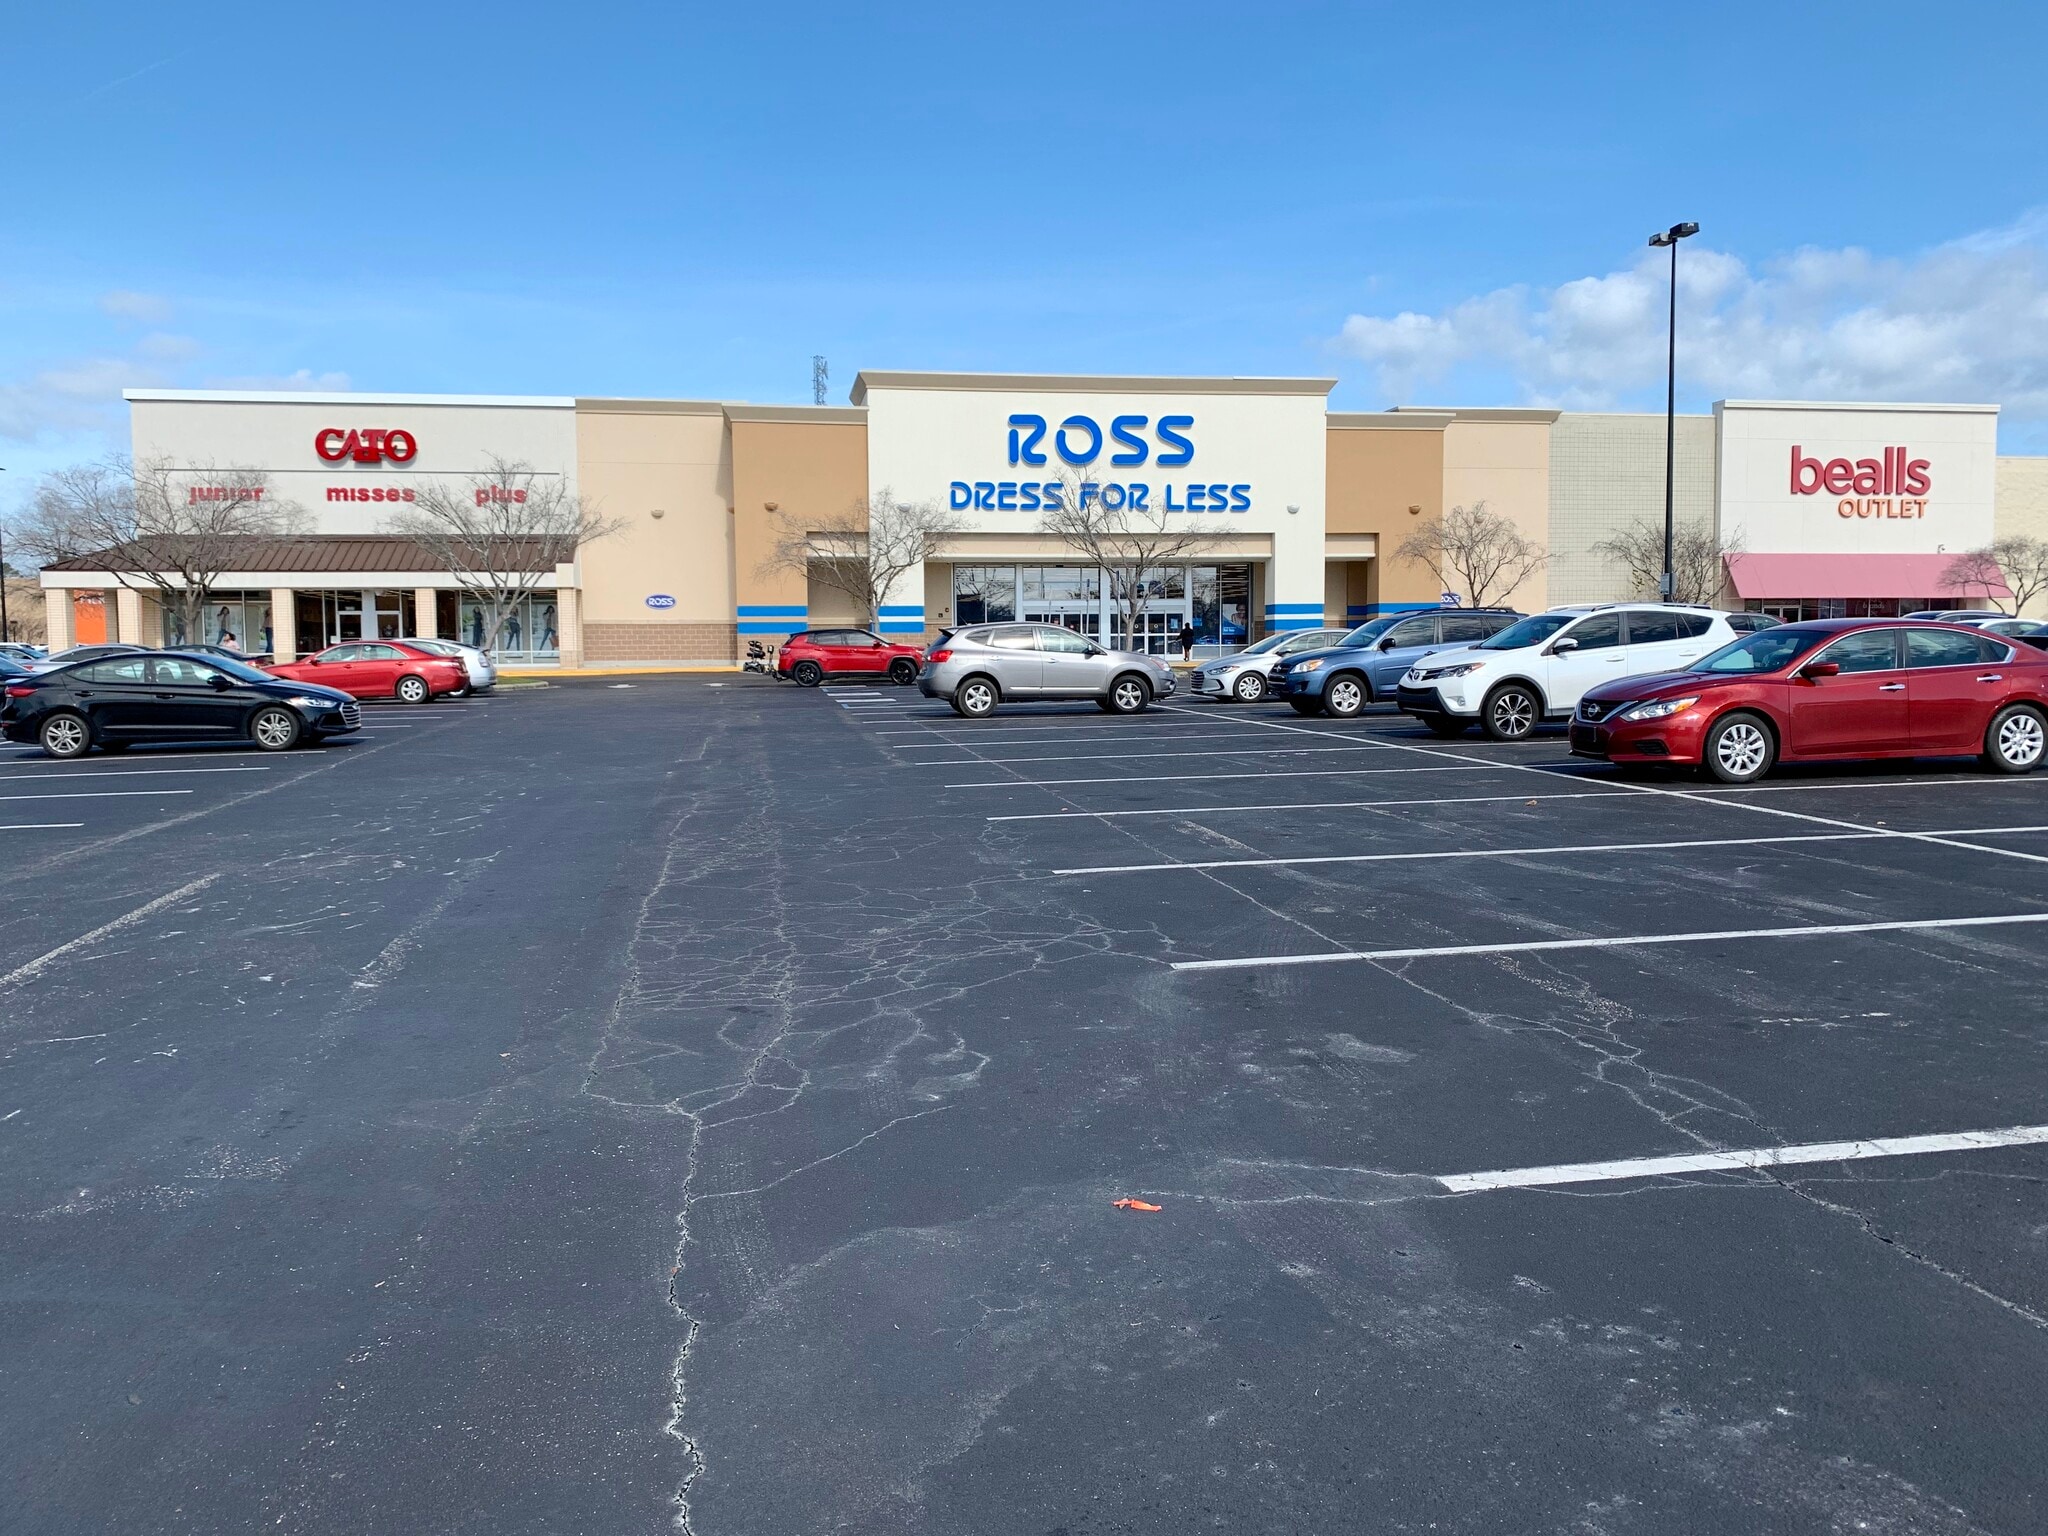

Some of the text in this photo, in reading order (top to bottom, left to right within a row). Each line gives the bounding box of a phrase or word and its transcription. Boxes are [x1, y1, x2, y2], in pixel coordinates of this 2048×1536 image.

[315, 428, 417, 463] CATO
[1007, 414, 1195, 466] ROSS
[1790, 445, 1932, 496] bealls
[188, 484, 527, 507] junior misses plus
[950, 481, 1252, 512] DRESS FOR LESS
[1838, 498, 1929, 519] OUTLET
[648, 597, 674, 606] ROSS
